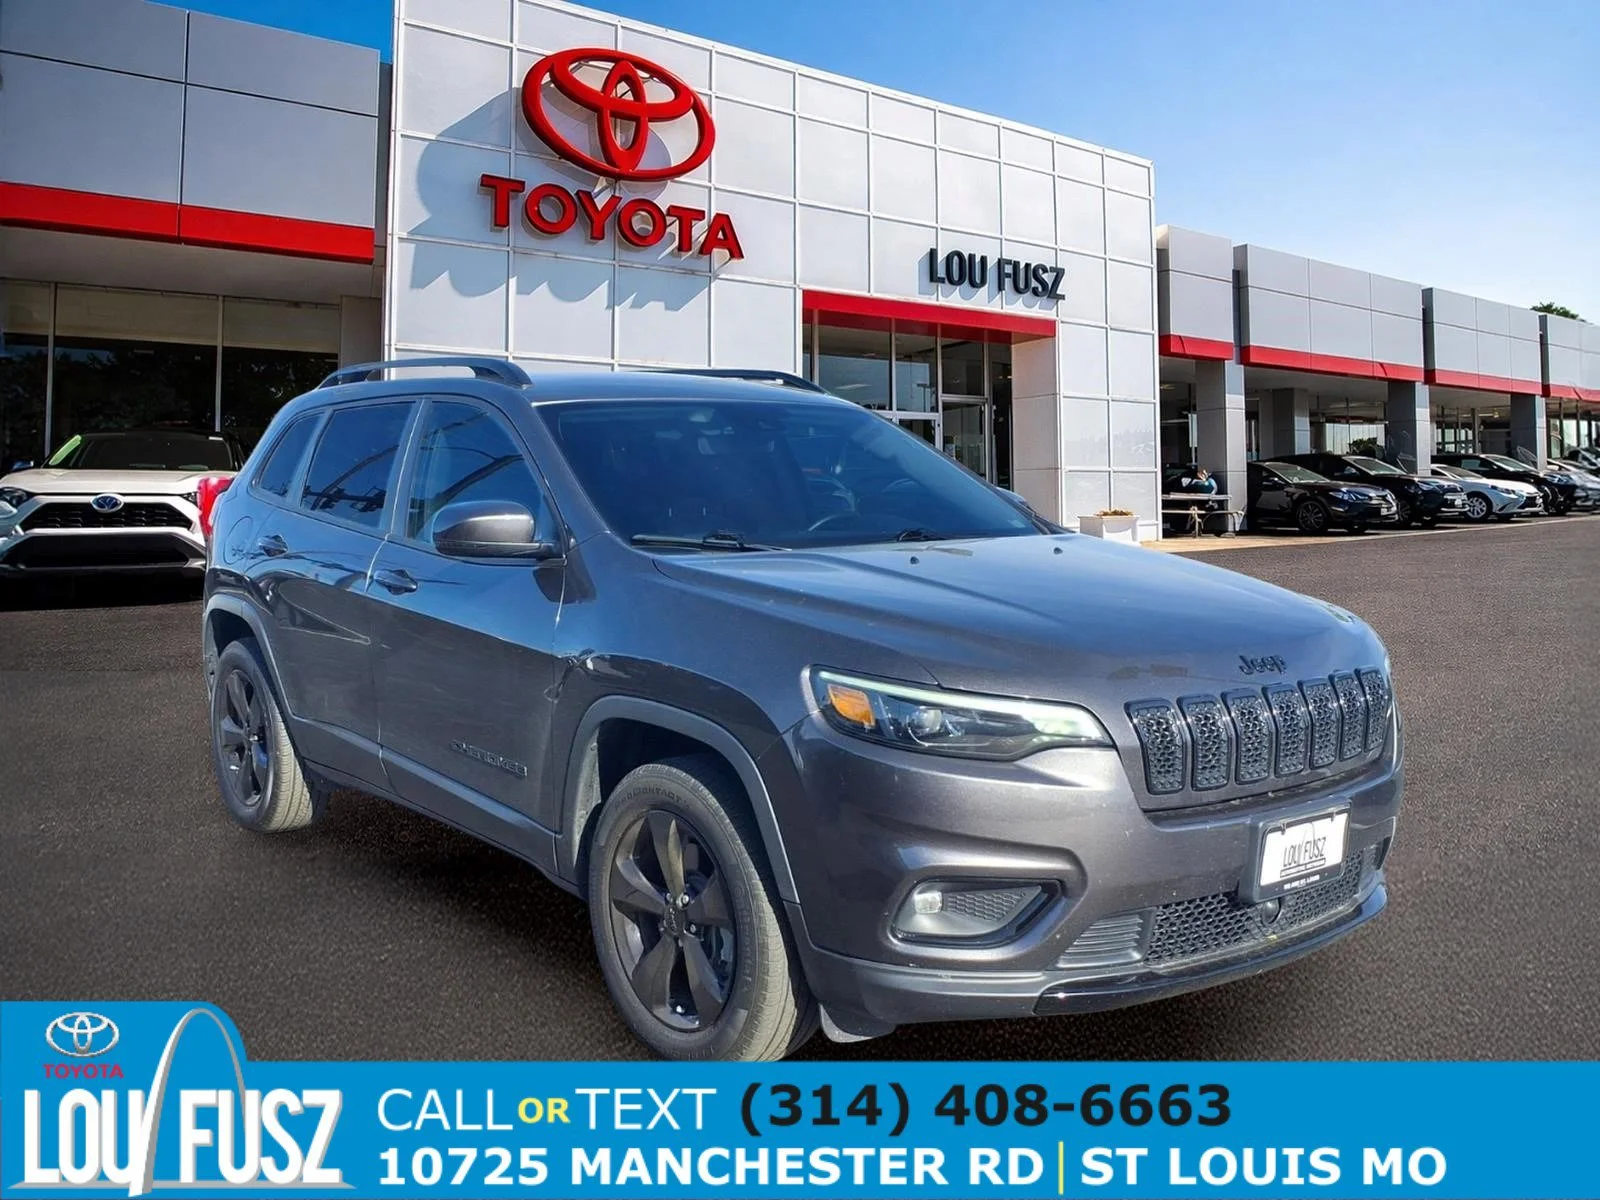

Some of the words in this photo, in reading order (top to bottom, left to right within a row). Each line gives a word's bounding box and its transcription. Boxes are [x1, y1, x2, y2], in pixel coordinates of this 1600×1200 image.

[481, 173, 743, 259] TOYOTA
[929, 247, 988, 289] LOU
[999, 257, 1066, 300] FUSZ
[1238, 654, 1287, 675] Jeep
